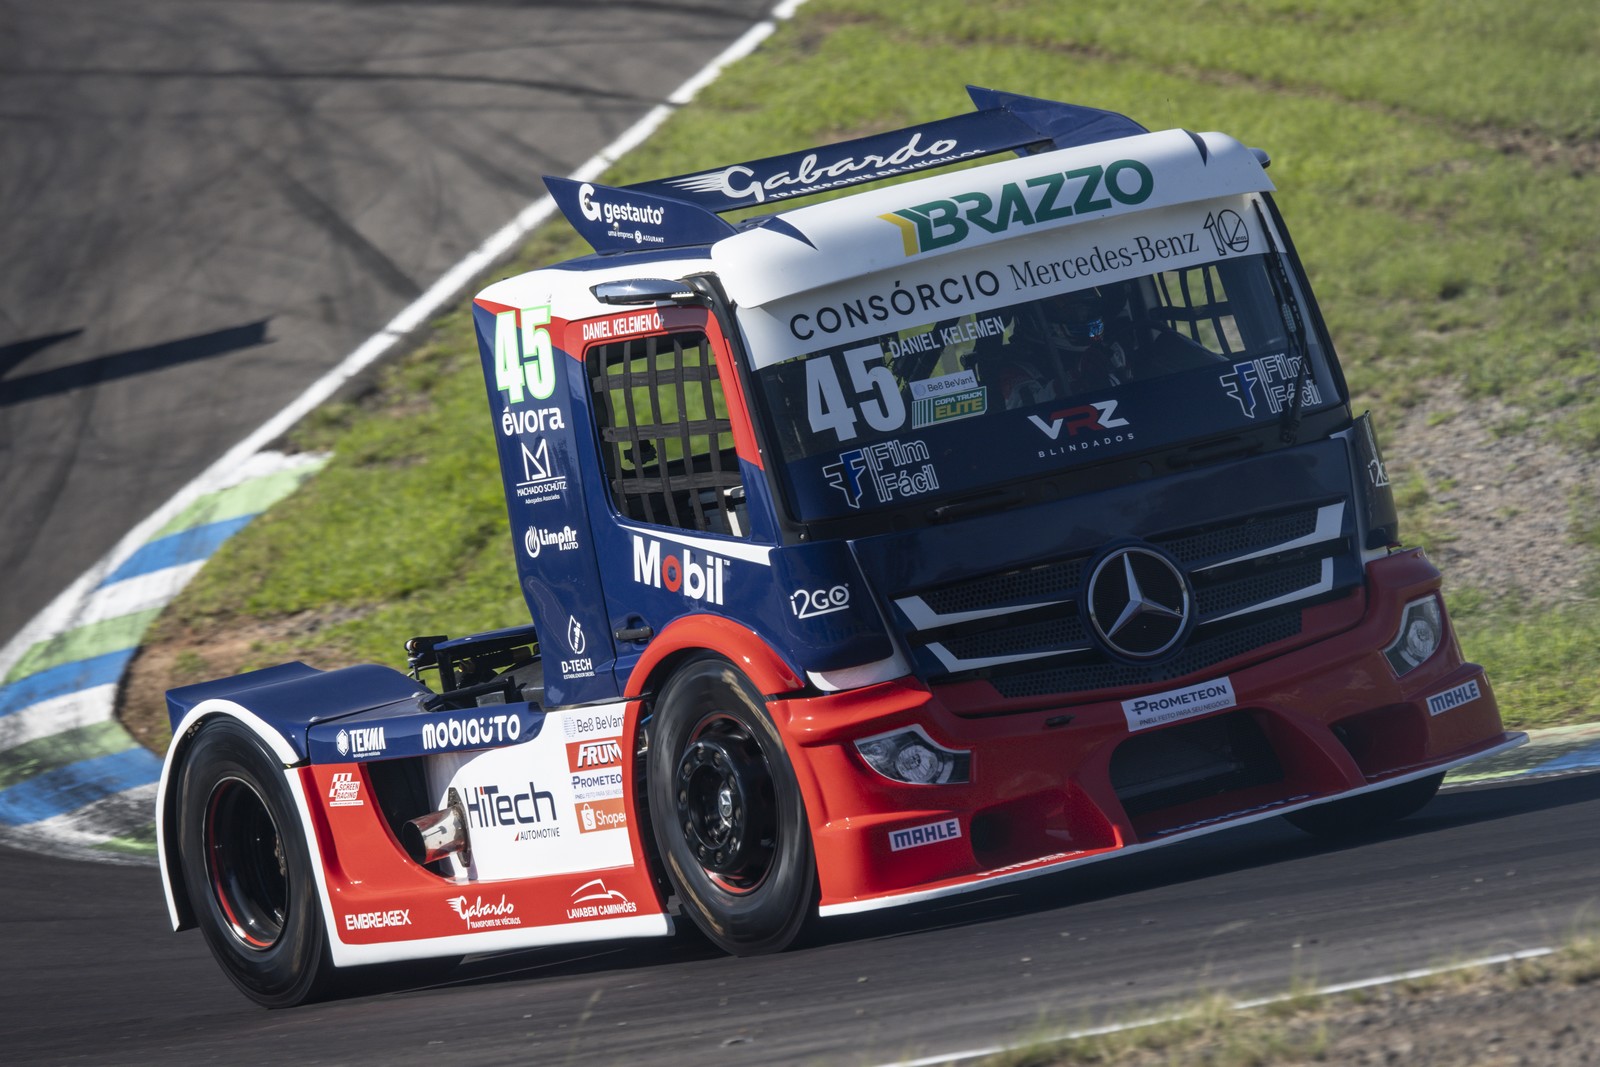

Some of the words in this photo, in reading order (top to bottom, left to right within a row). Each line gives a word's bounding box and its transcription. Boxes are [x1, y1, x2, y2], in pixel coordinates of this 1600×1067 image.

[720, 133, 957, 202] Gabardo
[892, 159, 1154, 254] BRAZZO
[789, 270, 1000, 341] CONSÓRCIO
[1007, 230, 1199, 291] Mercedes-Benz
[583, 320, 612, 341] DANIEL
[613, 314, 652, 335] KELEMEN
[889, 332, 940, 358] DANIEL
[940, 317, 1005, 346] KELEMEN
[495, 304, 556, 404] 45
[806, 344, 906, 441] 45
[927, 382, 944, 392] Be8
[944, 376, 974, 388] BeVant
[935, 397, 955, 406] COPA
[957, 391, 983, 400] TRUCK
[935, 398, 983, 419] ELITE
[502, 406, 565, 436] évora
[1027, 400, 1130, 440] VRZ
[870, 439, 930, 471] Film
[1038, 432, 1135, 458] BLINDADOS
[517, 485, 544, 497] MACHADO
[880, 464, 939, 501] Fácil
[563, 541, 579, 550] AUTO
[633, 535, 724, 606] Mobil
[561, 658, 592, 673] D-TECH
[1158, 712, 1175, 722] FEITO
[1176, 708, 1191, 717] PARA
[1191, 705, 1203, 714] SEU
[1203, 698, 1230, 711] NEGÓCIO
[1430, 683, 1478, 712] MAHLE
[577, 717, 594, 733] Be8
[349, 727, 386, 753] TEKMA
[336, 791, 357, 800] RACING
[339, 783, 359, 791] SCREEN
[464, 781, 557, 829] HiTech
[520, 827, 561, 841] AUTOMOTIVE
[894, 821, 957, 848] MAHLE
[344, 909, 412, 931] EMBREAGEX
[456, 893, 514, 930] Gabardo
[566, 906, 598, 919] LAVABEM
[598, 901, 637, 915] CAMINHÕES
[470, 919, 495, 929] TRANSPORTE
[495, 918, 501, 926] DE
